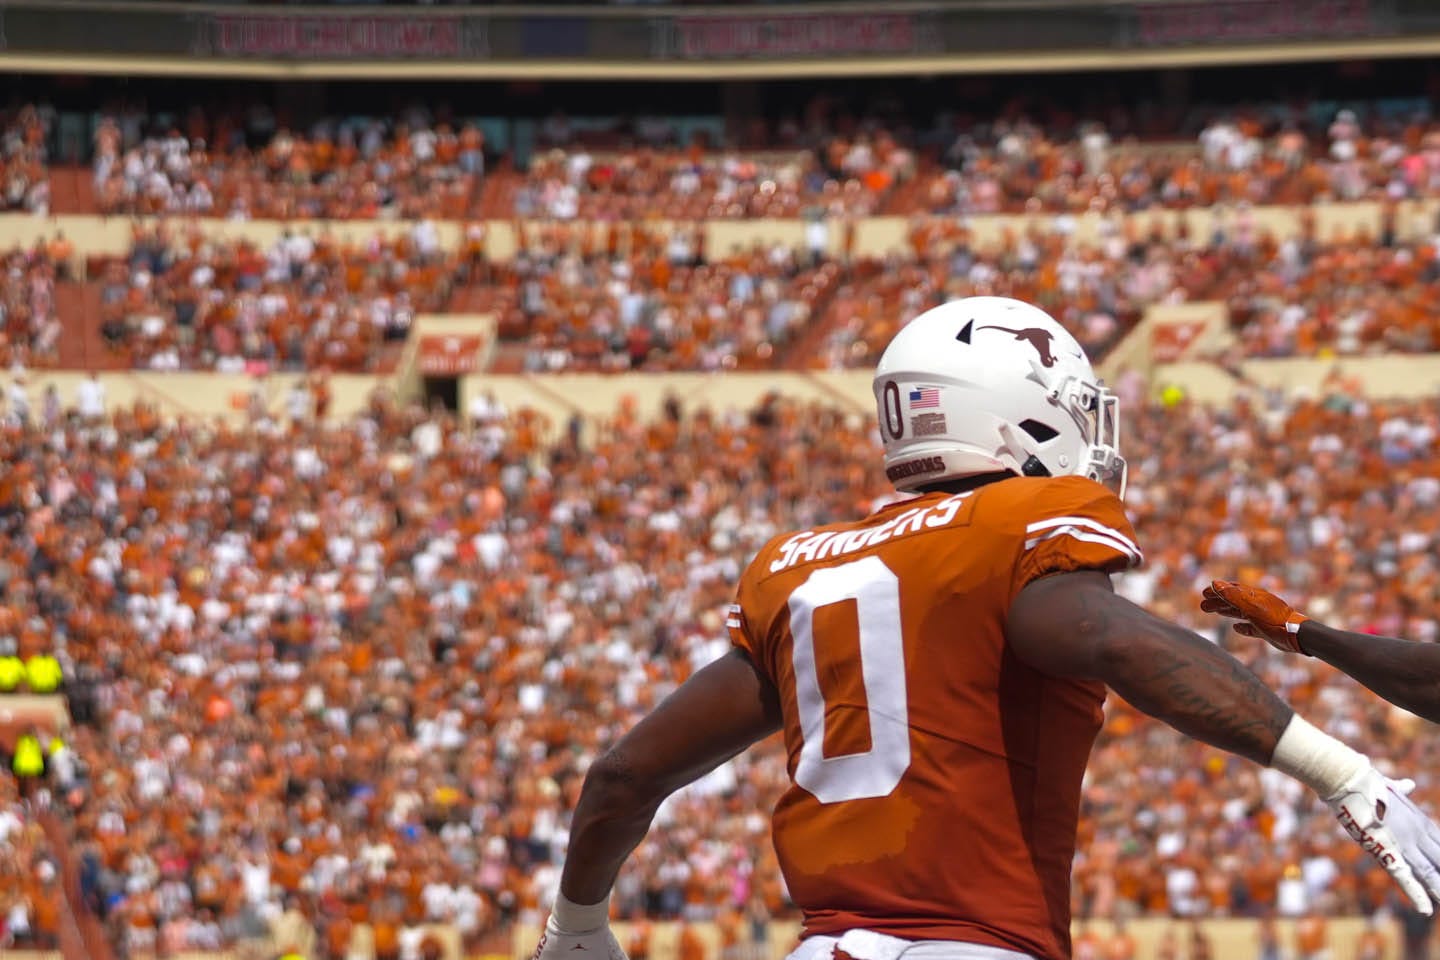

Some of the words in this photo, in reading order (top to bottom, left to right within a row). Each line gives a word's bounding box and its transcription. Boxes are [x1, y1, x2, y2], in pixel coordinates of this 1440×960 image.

[884, 381, 904, 440] 0
[768, 491, 973, 573] SANDERS
[788, 555, 911, 804] 0
[1337, 805, 1396, 868] TEXAS
